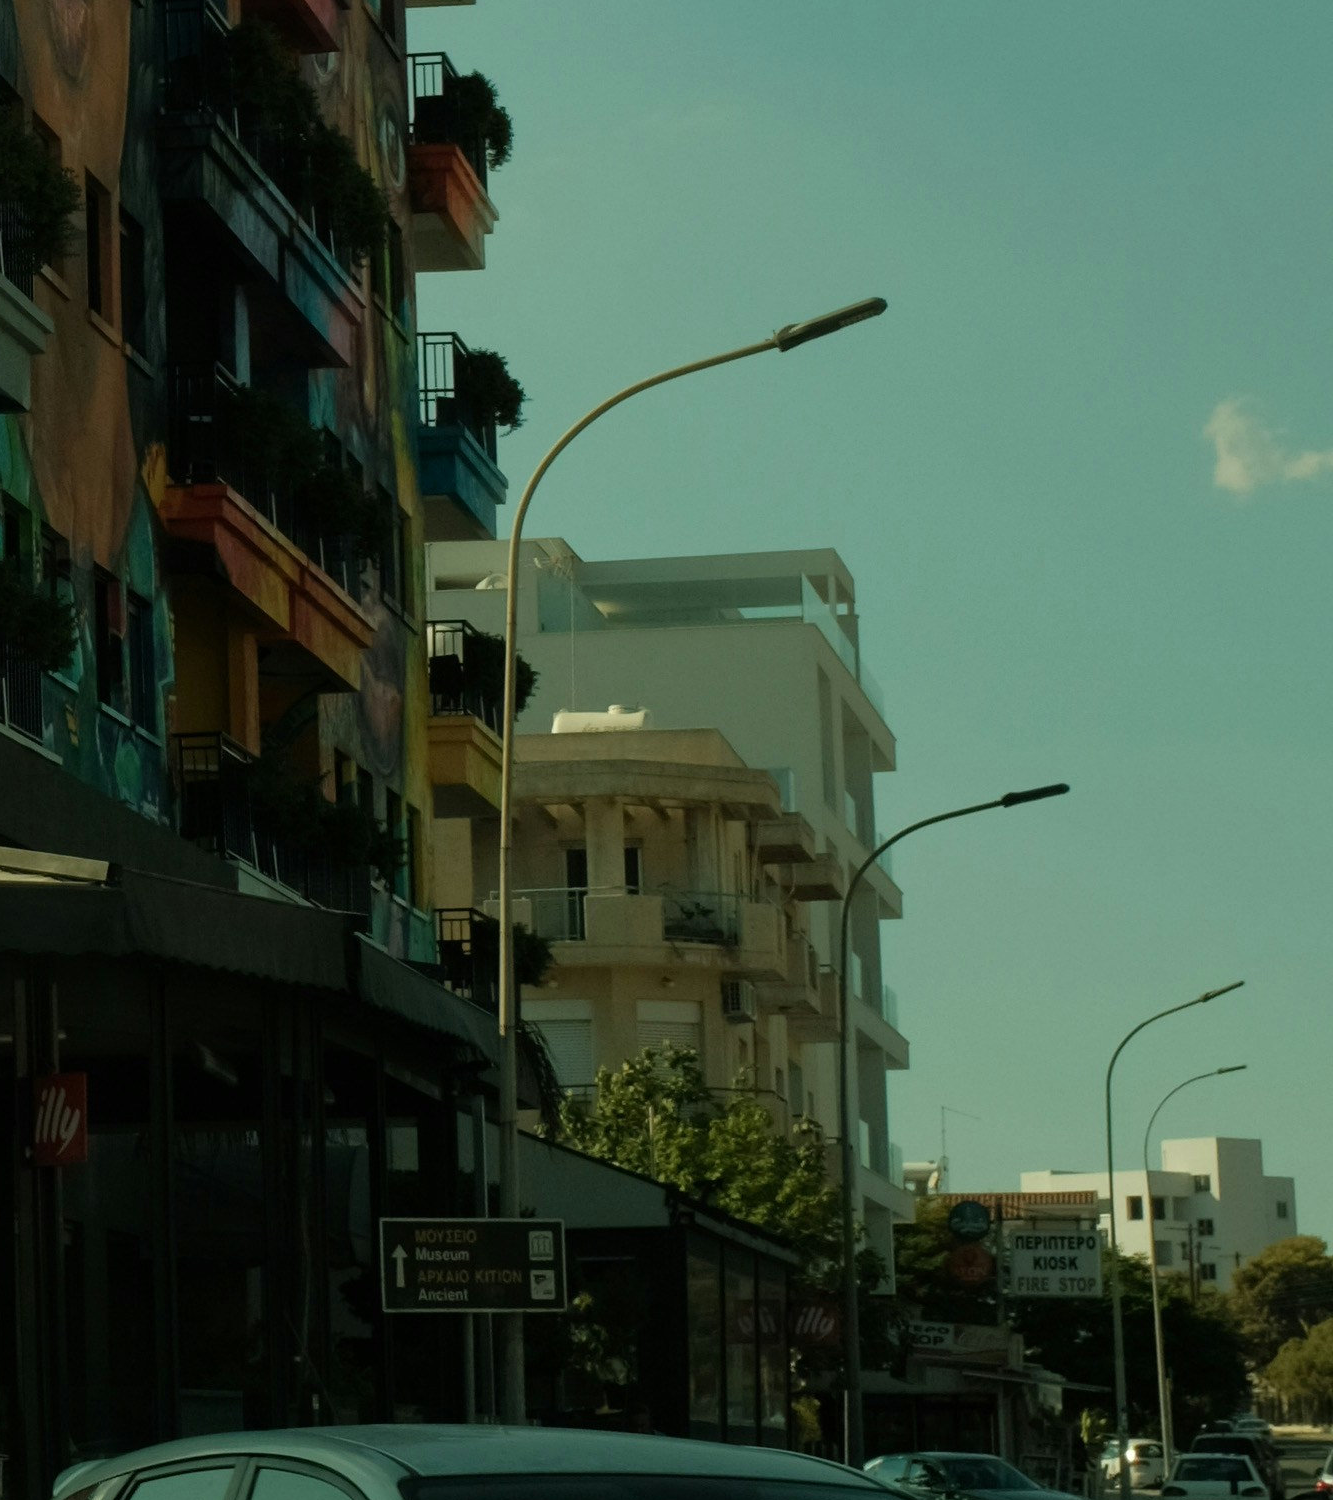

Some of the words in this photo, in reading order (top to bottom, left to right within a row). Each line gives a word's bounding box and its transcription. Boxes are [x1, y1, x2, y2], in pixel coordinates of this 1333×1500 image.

[35, 1086, 81, 1157] illy
[414, 1229, 478, 1244] ΜΟΥΣΕΙΟ
[1015, 1236, 1096, 1250] ΠΕΡΙΠΤΕΡΟ
[415, 1246, 470, 1261] Museum
[1034, 1256, 1078, 1270] KIOSK
[417, 1269, 469, 1284] ΑΡΧΑΙΟ
[474, 1269, 523, 1284] ΚΙΤΙΟΝ
[1018, 1277, 1050, 1292] FIRE
[1059, 1277, 1097, 1293] STOP
[418, 1288, 469, 1302] Ancient
[795, 1307, 835, 1338] illy
